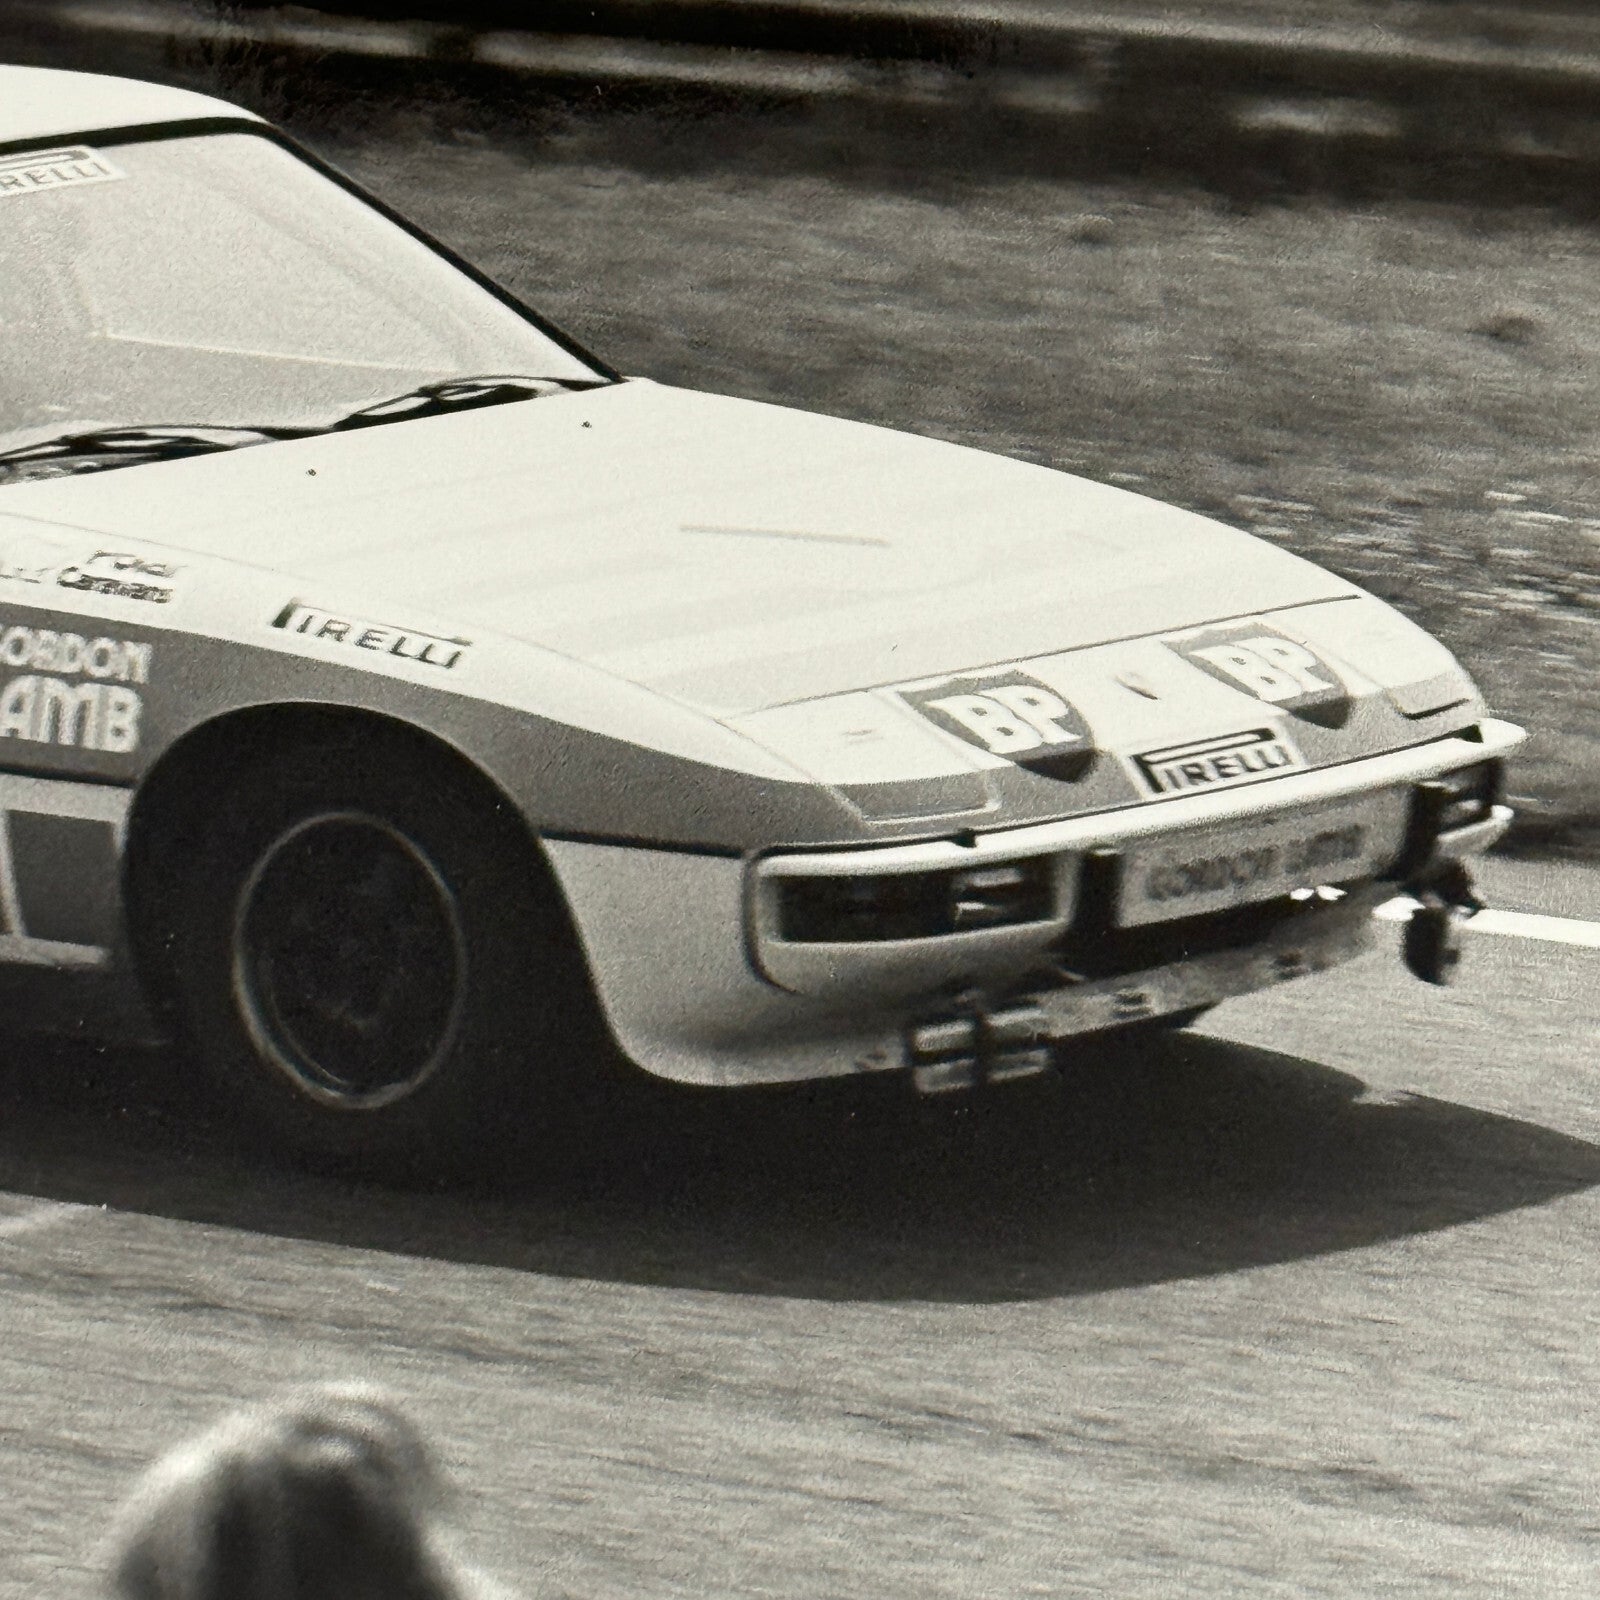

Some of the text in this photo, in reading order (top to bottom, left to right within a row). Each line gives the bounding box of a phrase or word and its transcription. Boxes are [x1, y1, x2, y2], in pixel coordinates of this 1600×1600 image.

[0, 623, 152, 684] ORDON
[271, 597, 473, 670] PIRELLI
[1188, 636, 1335, 702] BP
[924, 685, 1084, 755] BP
[1130, 727, 1293, 793] PIRELLI
